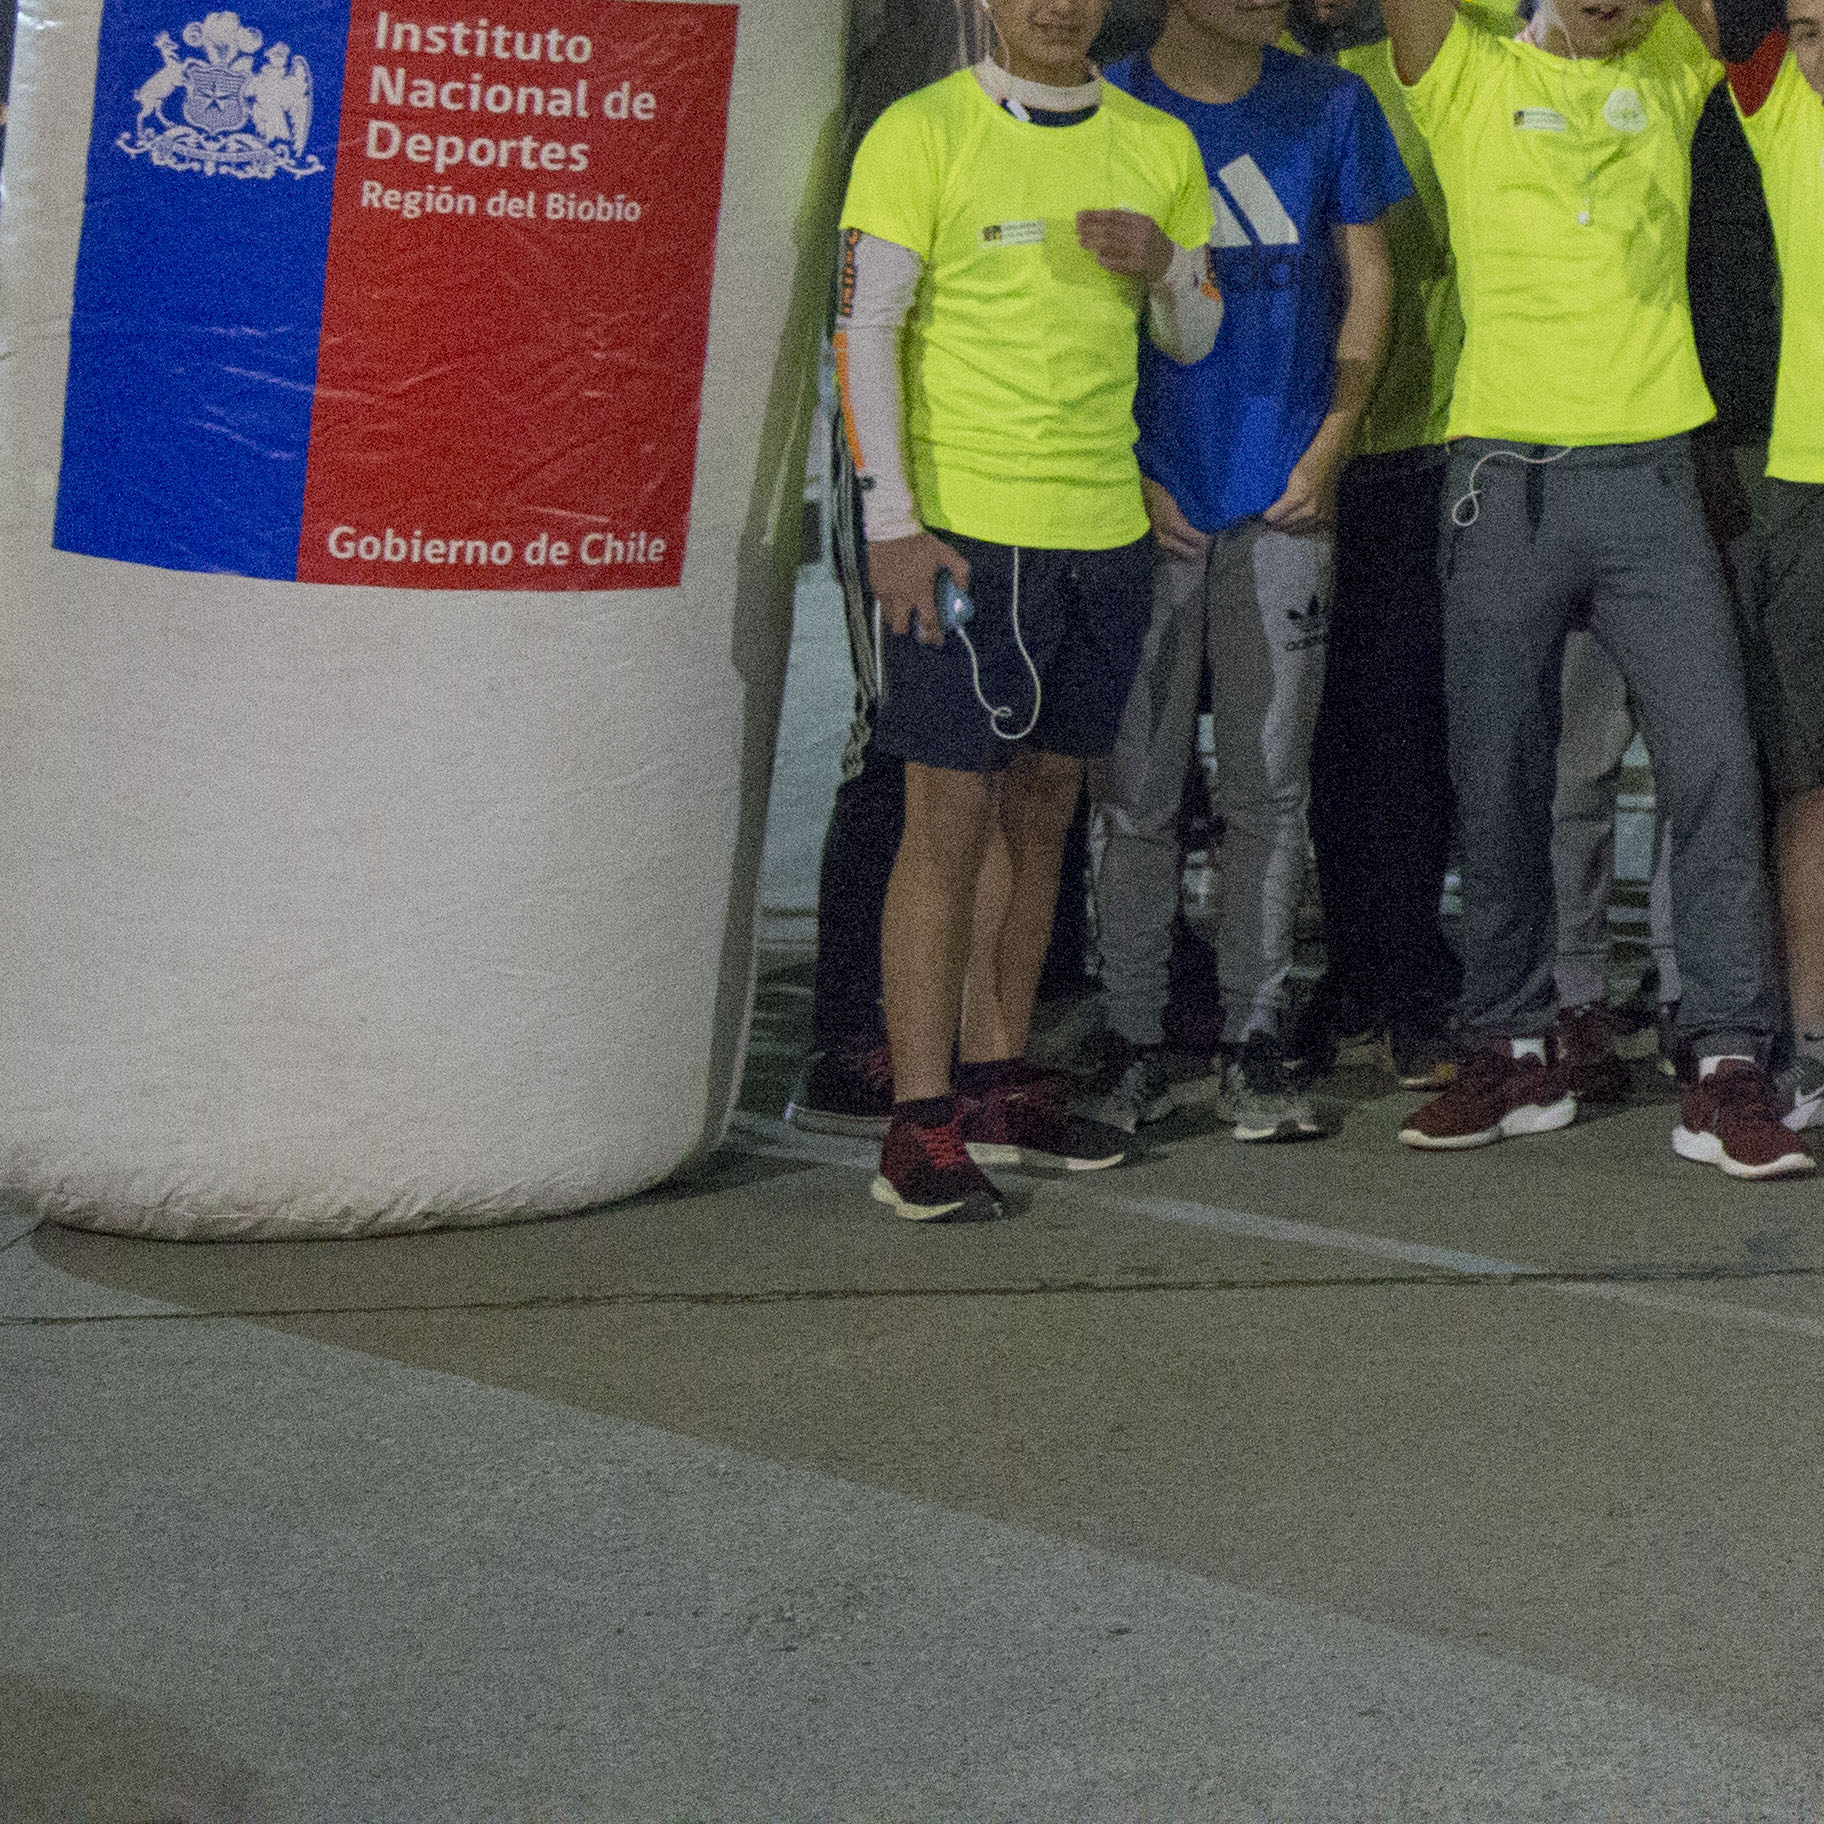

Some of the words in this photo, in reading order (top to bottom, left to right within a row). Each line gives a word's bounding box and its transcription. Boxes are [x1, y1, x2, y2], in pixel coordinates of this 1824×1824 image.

[375, 12, 592, 65] Instituto
[368, 67, 589, 118] Nacional
[603, 82, 657, 122] de
[366, 120, 589, 173] Deportes
[361, 181, 476, 218] Región
[486, 188, 535, 218] del
[327, 526, 514, 567] Gobierno
[524, 529, 570, 567] de
[579, 531, 666, 565] Chile
